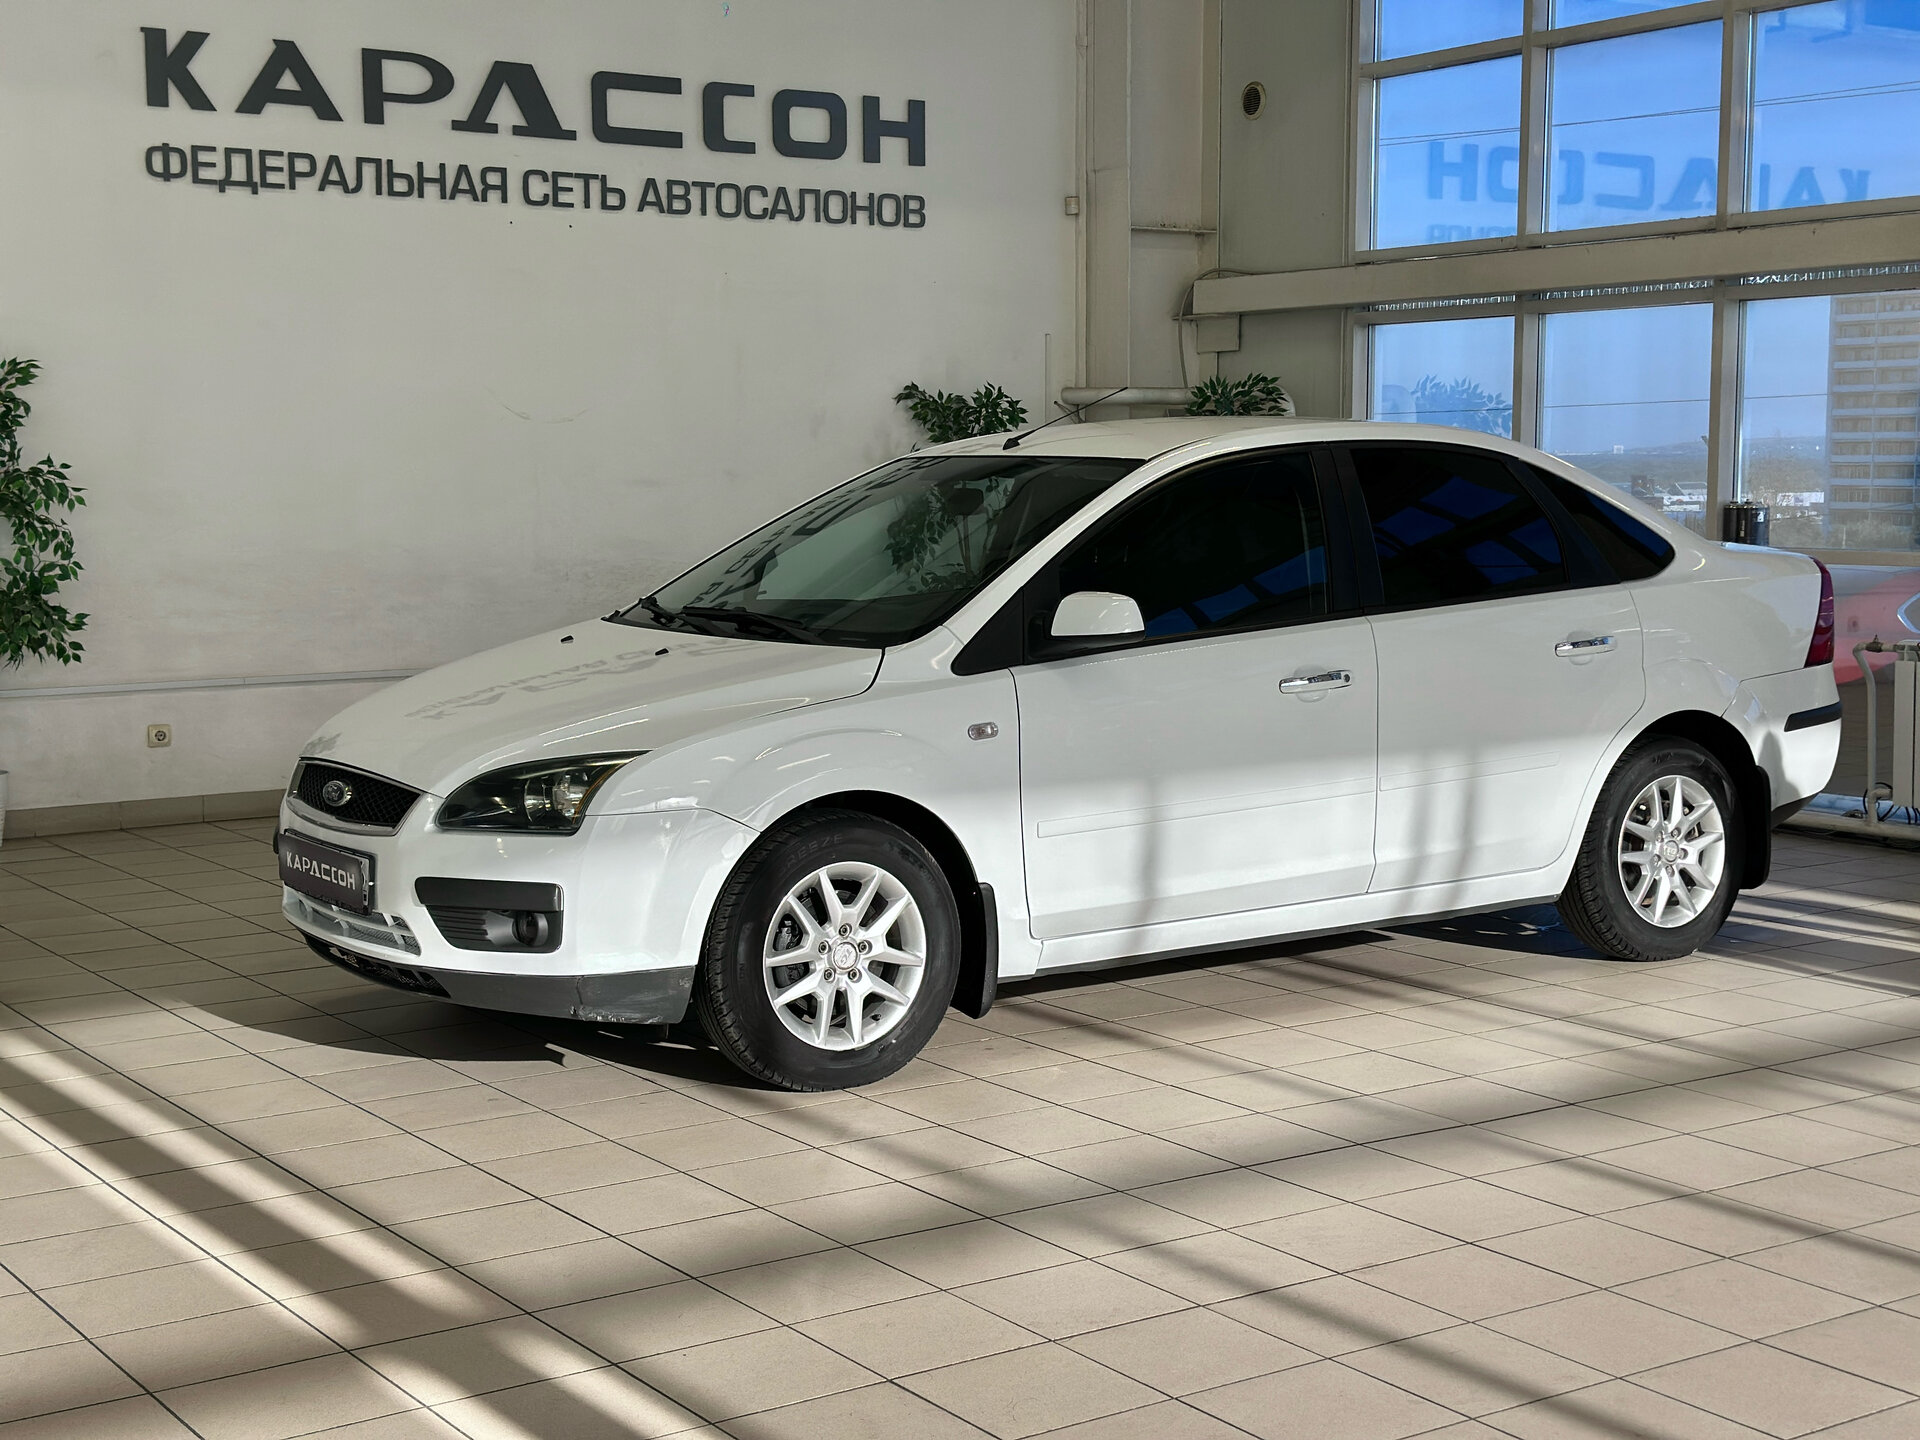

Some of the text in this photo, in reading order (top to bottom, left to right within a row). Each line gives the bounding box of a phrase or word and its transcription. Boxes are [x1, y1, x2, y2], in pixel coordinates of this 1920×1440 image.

[140, 27, 927, 167] КАРАССОН
[145, 142, 926, 230] ФЕДЕРАЛЬНАЯ СЕТЬ АВТОСАЛОНОВ
[286, 851, 356, 890] КАРАССОН
